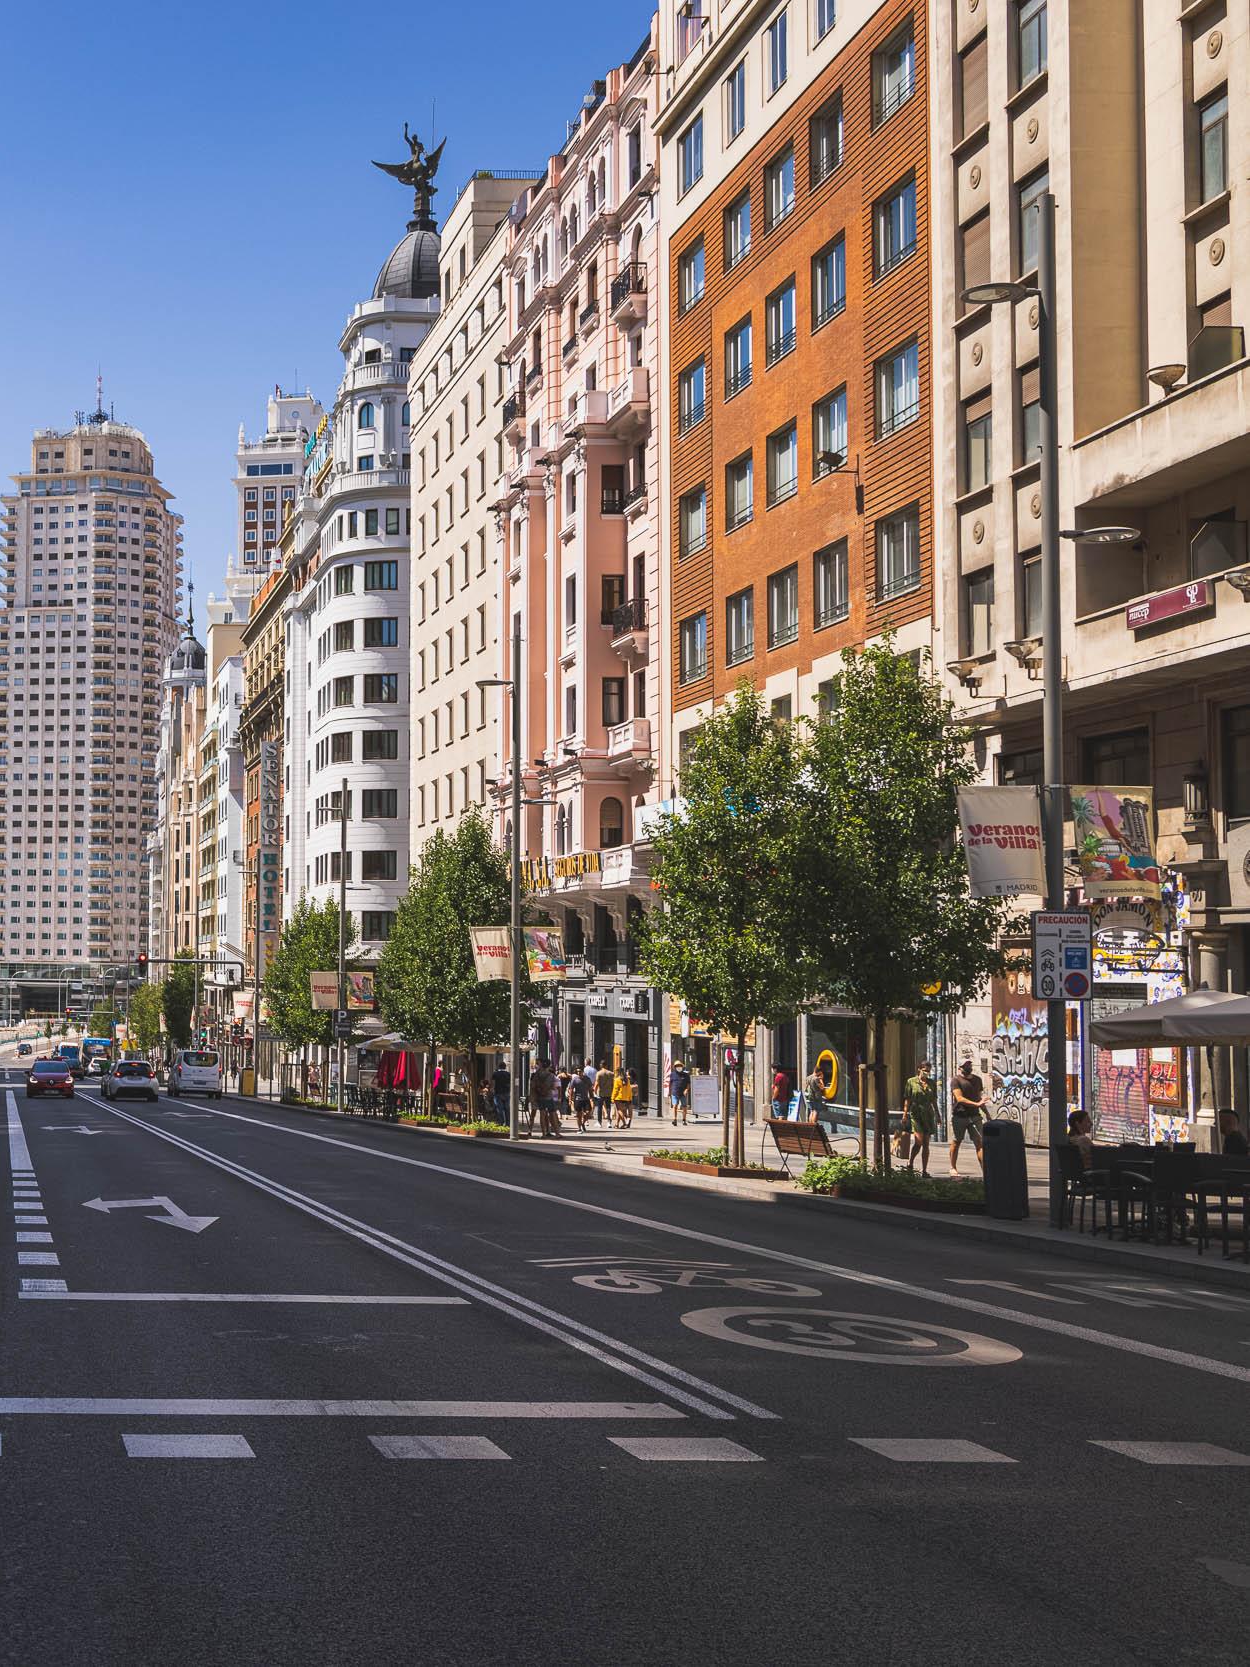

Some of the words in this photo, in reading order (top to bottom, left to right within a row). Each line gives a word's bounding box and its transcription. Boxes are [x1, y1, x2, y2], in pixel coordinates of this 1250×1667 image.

[262, 742, 279, 847] SENATOR
[968, 837, 982, 846] de
[982, 836, 992, 845] la
[994, 836, 1037, 849] Villa
[263, 853, 278, 931] HOTEL
[1006, 883, 1038, 892] MADRID
[1038, 915, 1088, 925] PRECAUCIÓN
[1094, 903, 1114, 928] DON
[338, 1011, 347, 1023] P
[747, 1318, 938, 1348] 30
